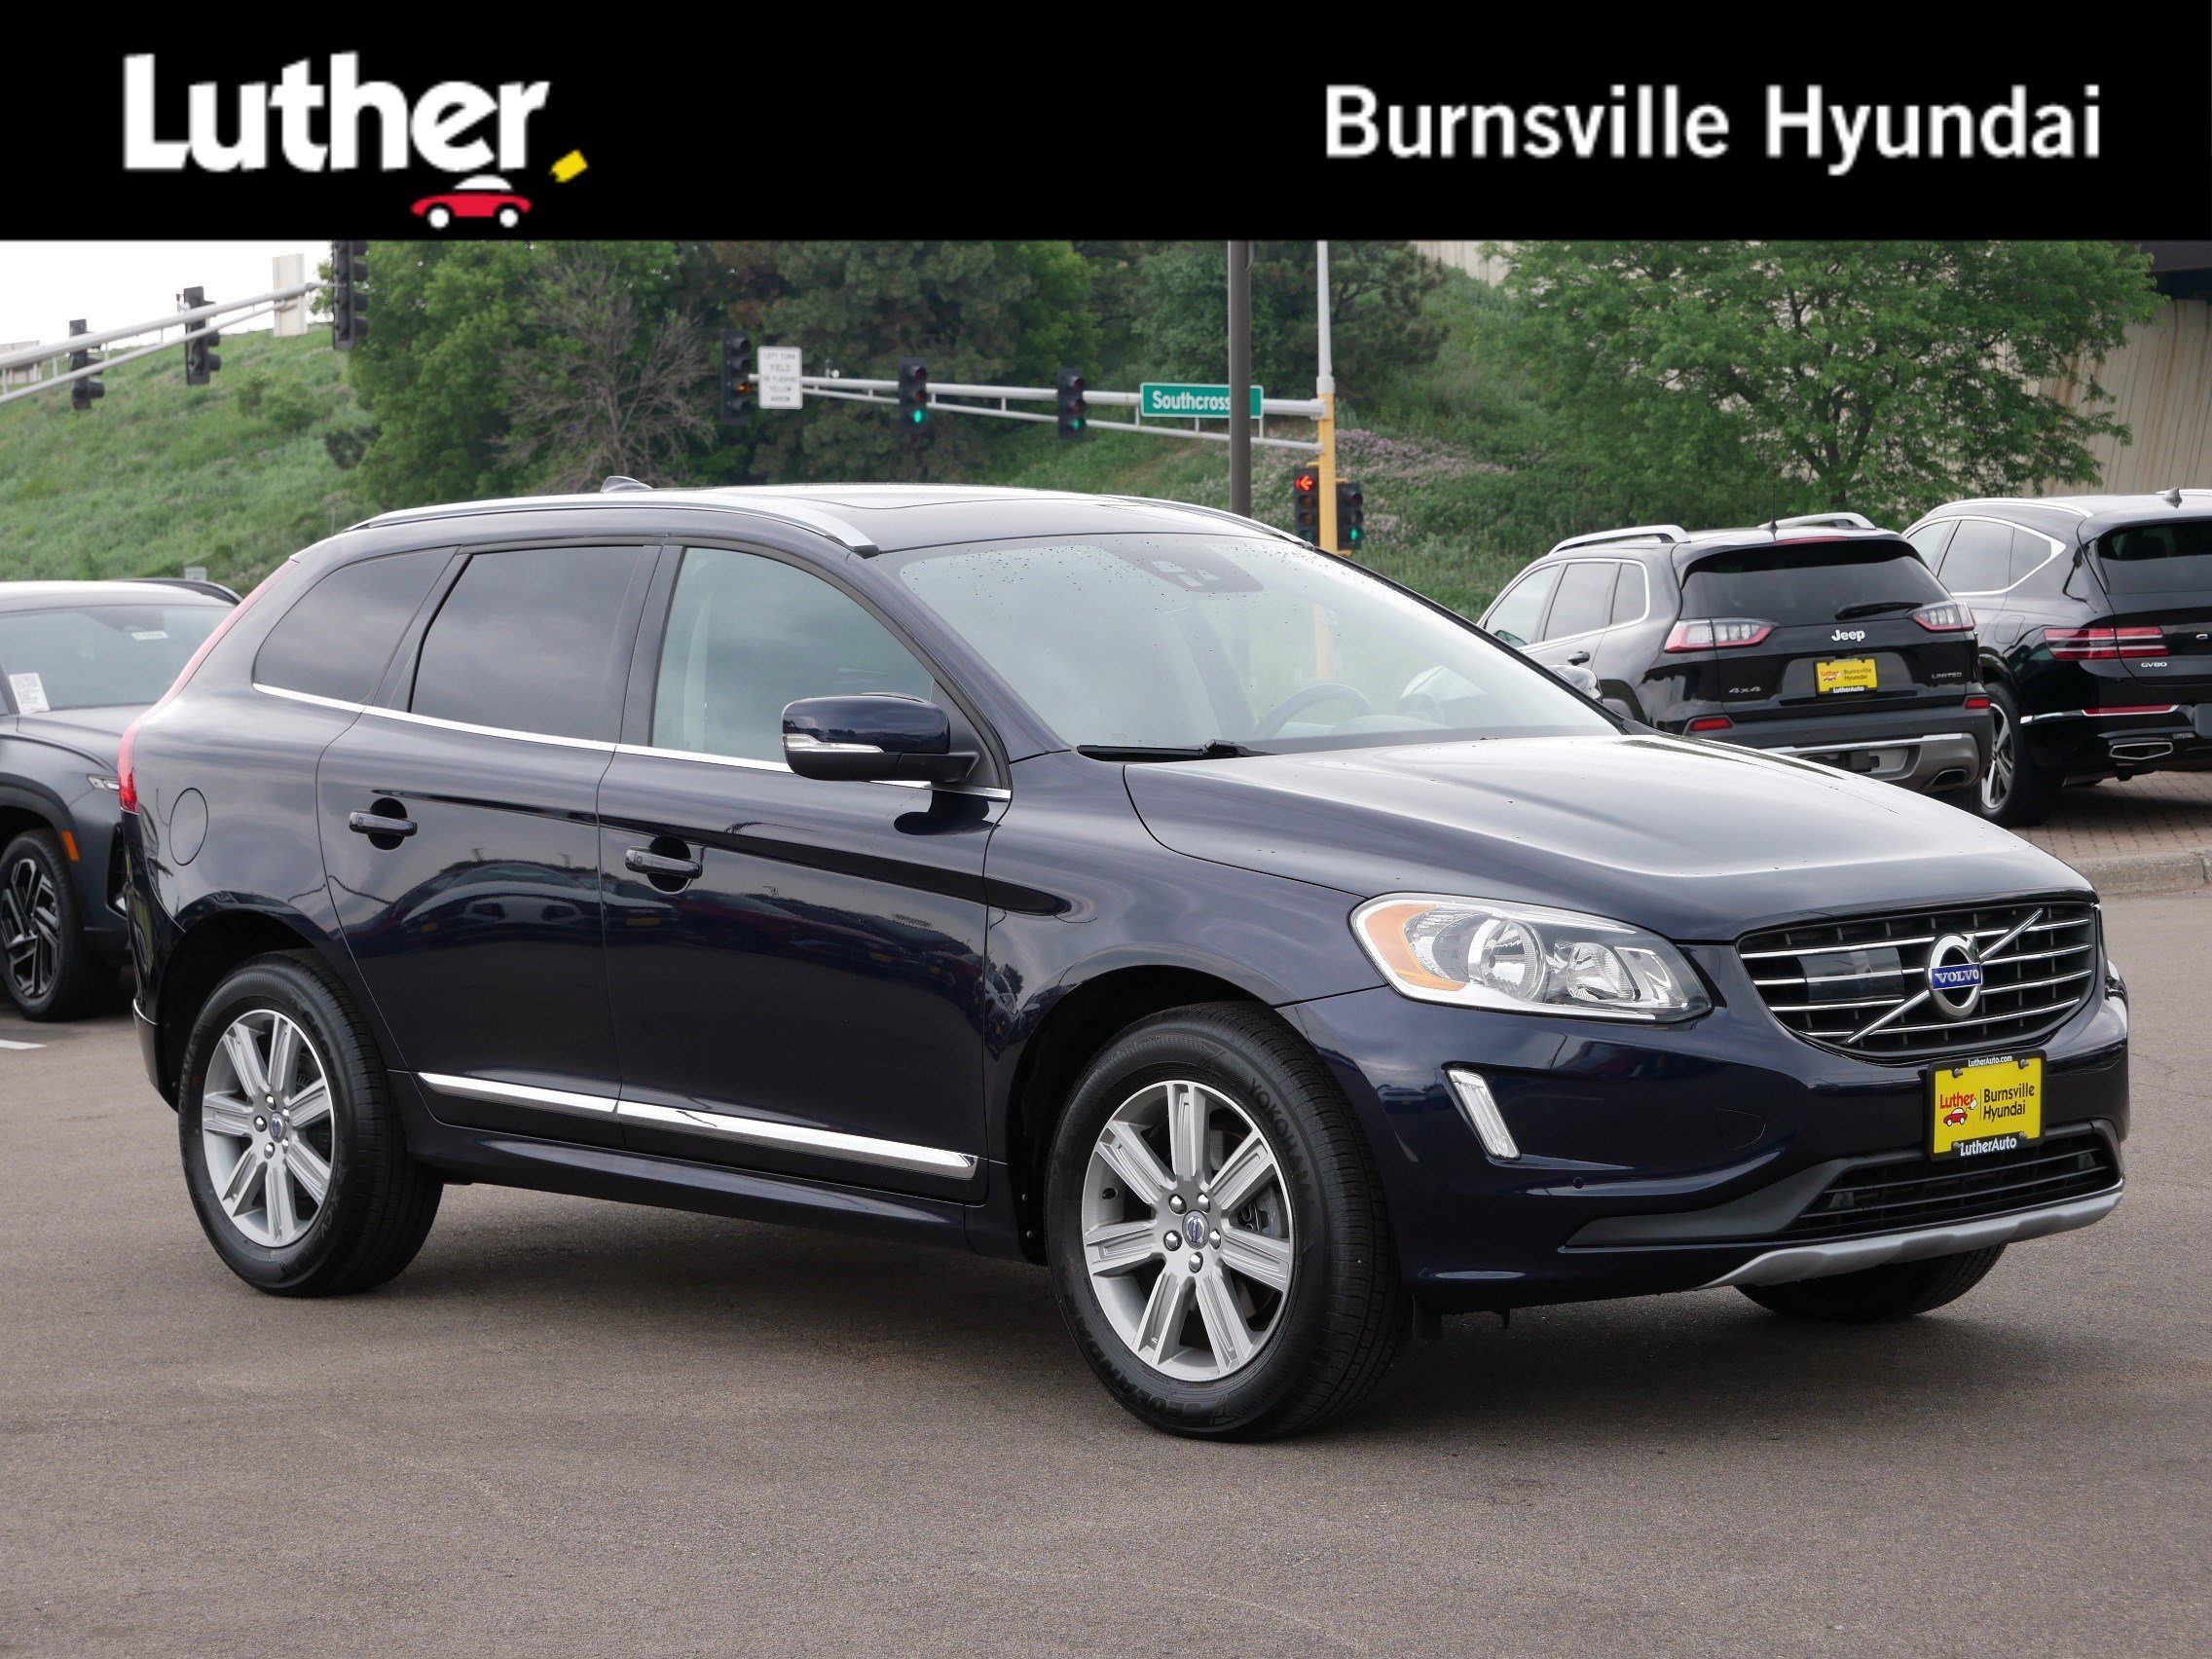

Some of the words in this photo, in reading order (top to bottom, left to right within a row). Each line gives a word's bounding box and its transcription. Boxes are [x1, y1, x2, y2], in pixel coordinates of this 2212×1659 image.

[1152, 389, 1231, 411] Southcross
[1831, 629, 1865, 642] Jeep
[1935, 969, 1979, 984] VOLVO
[1968, 1055, 2012, 1067] LutherAuto.com
[1939, 1091, 1975, 1109] Luther
[1983, 1082, 2035, 1104] Burnsville
[1983, 1100, 2026, 1123] Hyundai
[1960, 1135, 2017, 1157] LutherAuto
